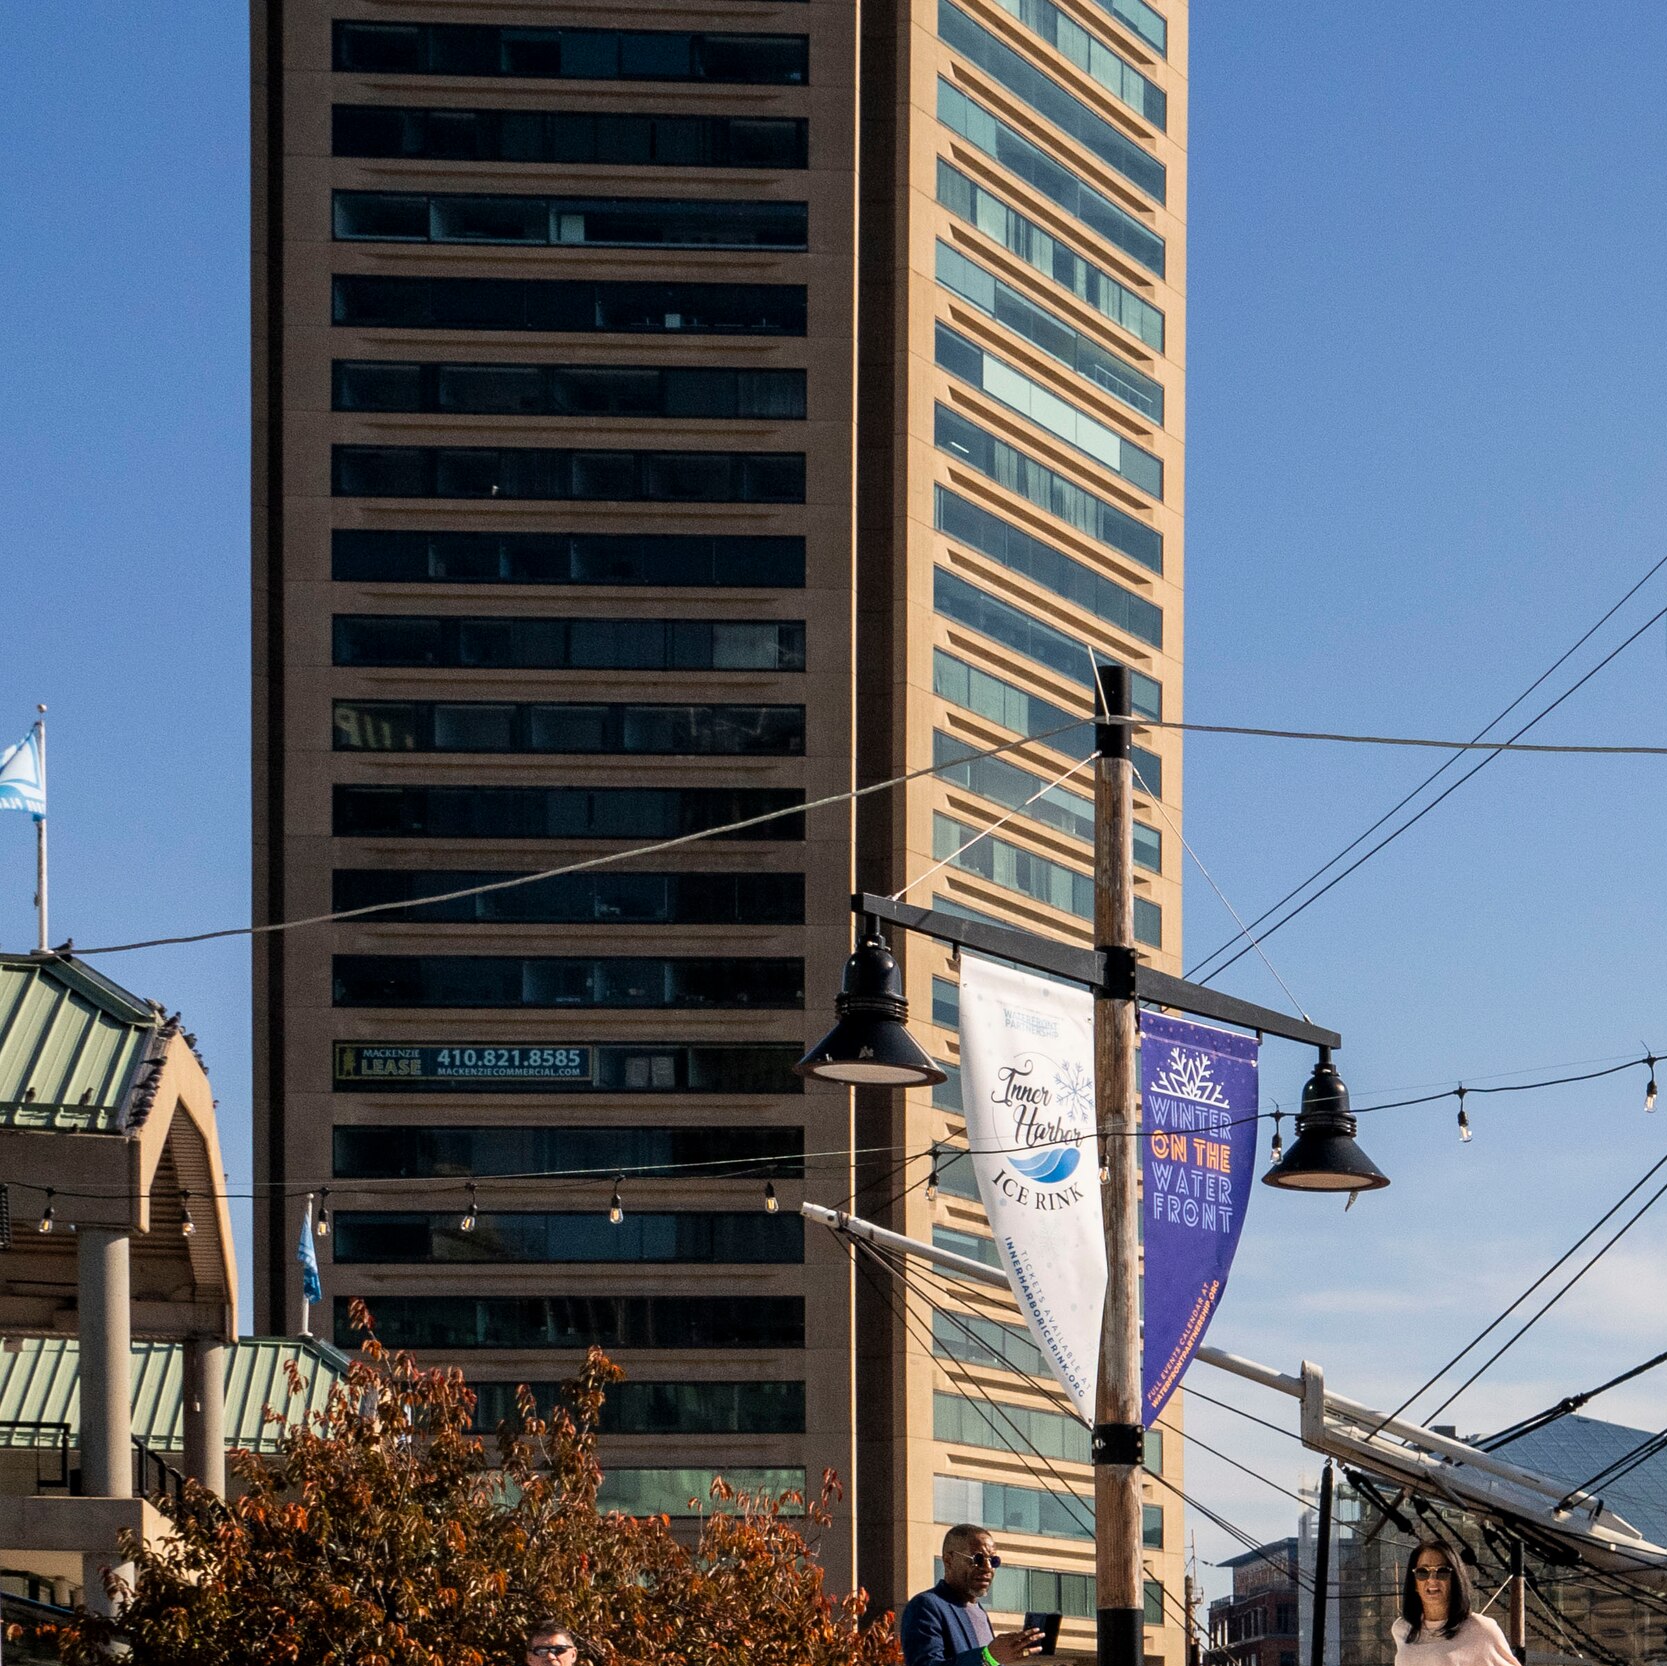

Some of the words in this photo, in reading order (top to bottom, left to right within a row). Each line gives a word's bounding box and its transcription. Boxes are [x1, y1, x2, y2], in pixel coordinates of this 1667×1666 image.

[361, 1058, 422, 1075] LEASE
[363, 1049, 420, 1058] MACKENZIE
[437, 1049, 581, 1066] 410.821.8585
[437, 1067, 581, 1076] MACKENZIECOMMERCIAL.COM
[991, 1059, 1050, 1107] Inner
[1012, 1104, 1083, 1148] Harbor
[1148, 1094, 1232, 1140] WINTER
[1151, 1129, 1188, 1163] ON
[1193, 1137, 1231, 1174] THE
[991, 1168, 1030, 1206] ICE
[1035, 1181, 1085, 1211] RINK
[1151, 1161, 1232, 1205] WATER
[1153, 1192, 1233, 1234] FRONT
[1004, 1236, 1086, 1398] INNERHARBORICERINK.ORG
[1020, 1250, 1046, 1304] TICKETS
[1044, 1309, 1081, 1373] AVAILABLE
[1080, 1377, 1092, 1394] AT
[1147, 1381, 1163, 1401] FULL
[1160, 1346, 1181, 1380] EVENTS
[1179, 1297, 1205, 1346] CALENDAR
[1151, 1279, 1220, 1409] WATERFRONTPARTNERSHIP.ORG
